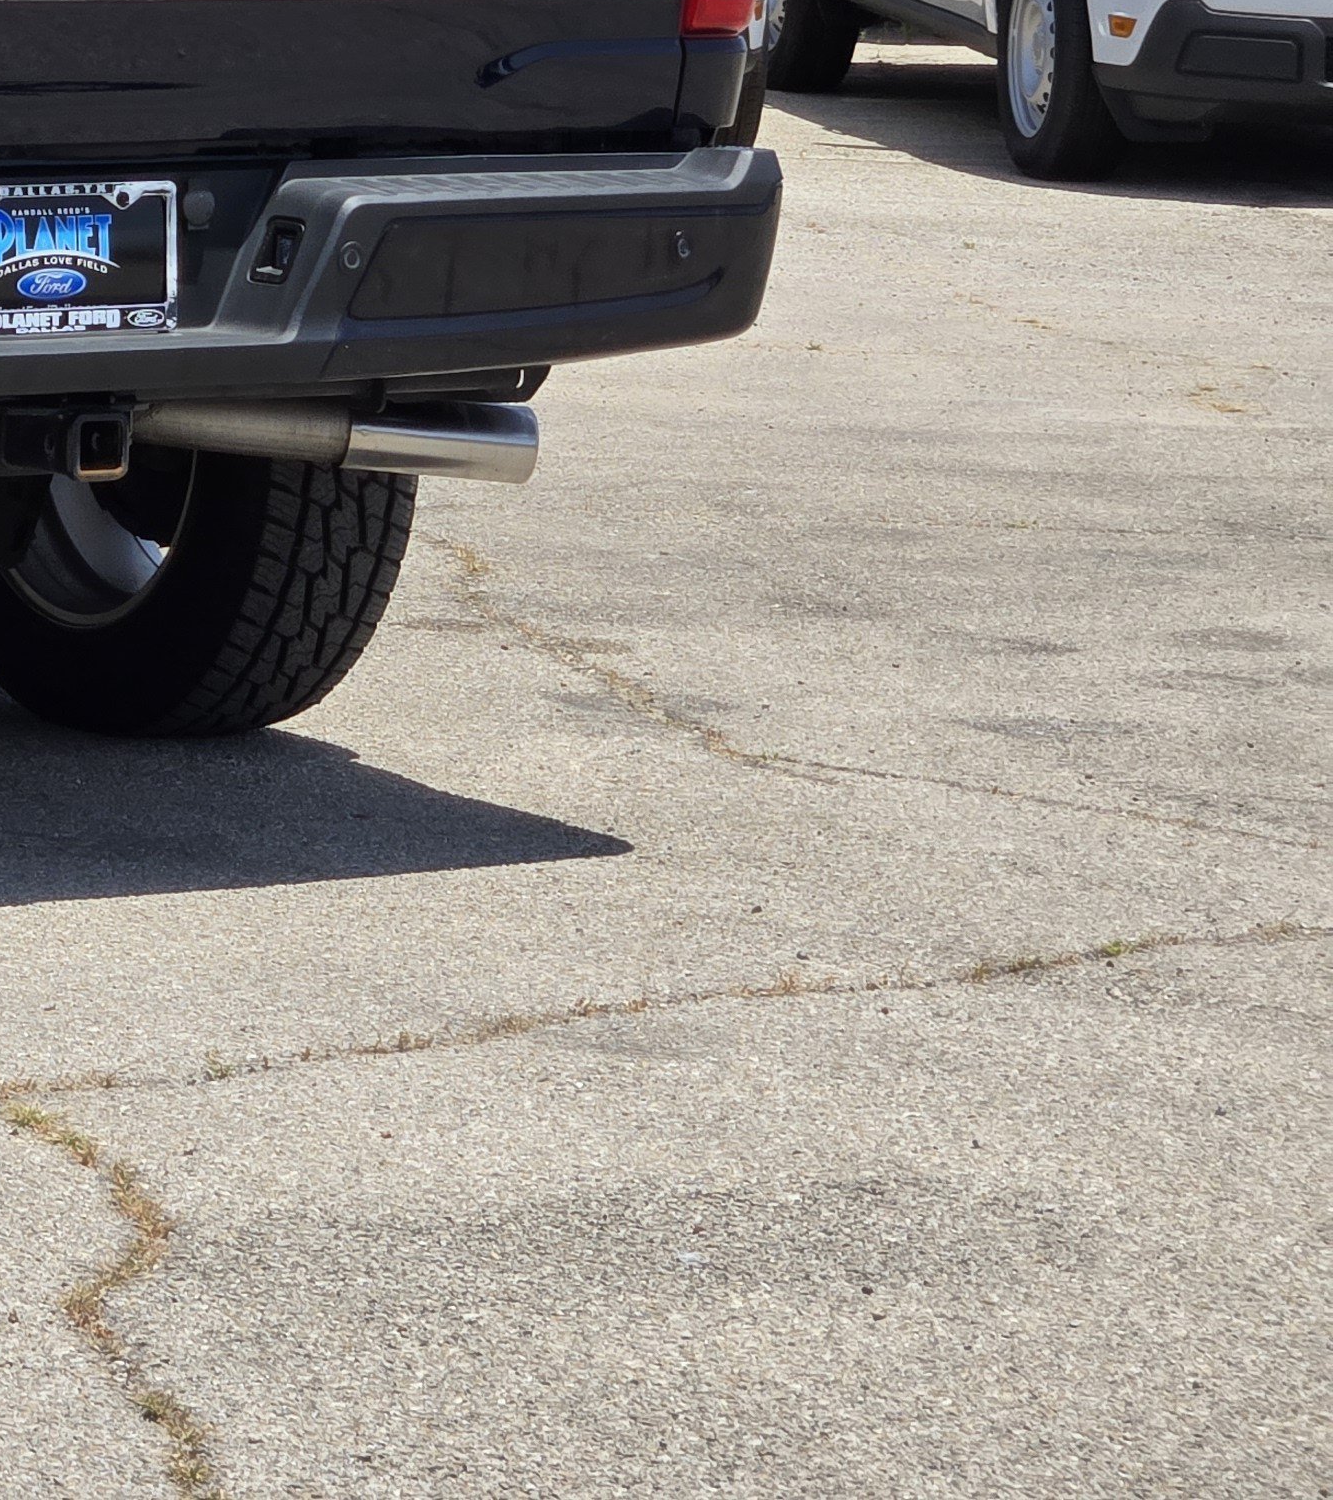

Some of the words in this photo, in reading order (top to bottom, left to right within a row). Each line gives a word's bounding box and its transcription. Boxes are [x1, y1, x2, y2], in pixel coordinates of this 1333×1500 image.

[44, 256, 73, 266] LOVE
[77, 257, 109, 274] FIELD
[68, 308, 121, 328] FORD
